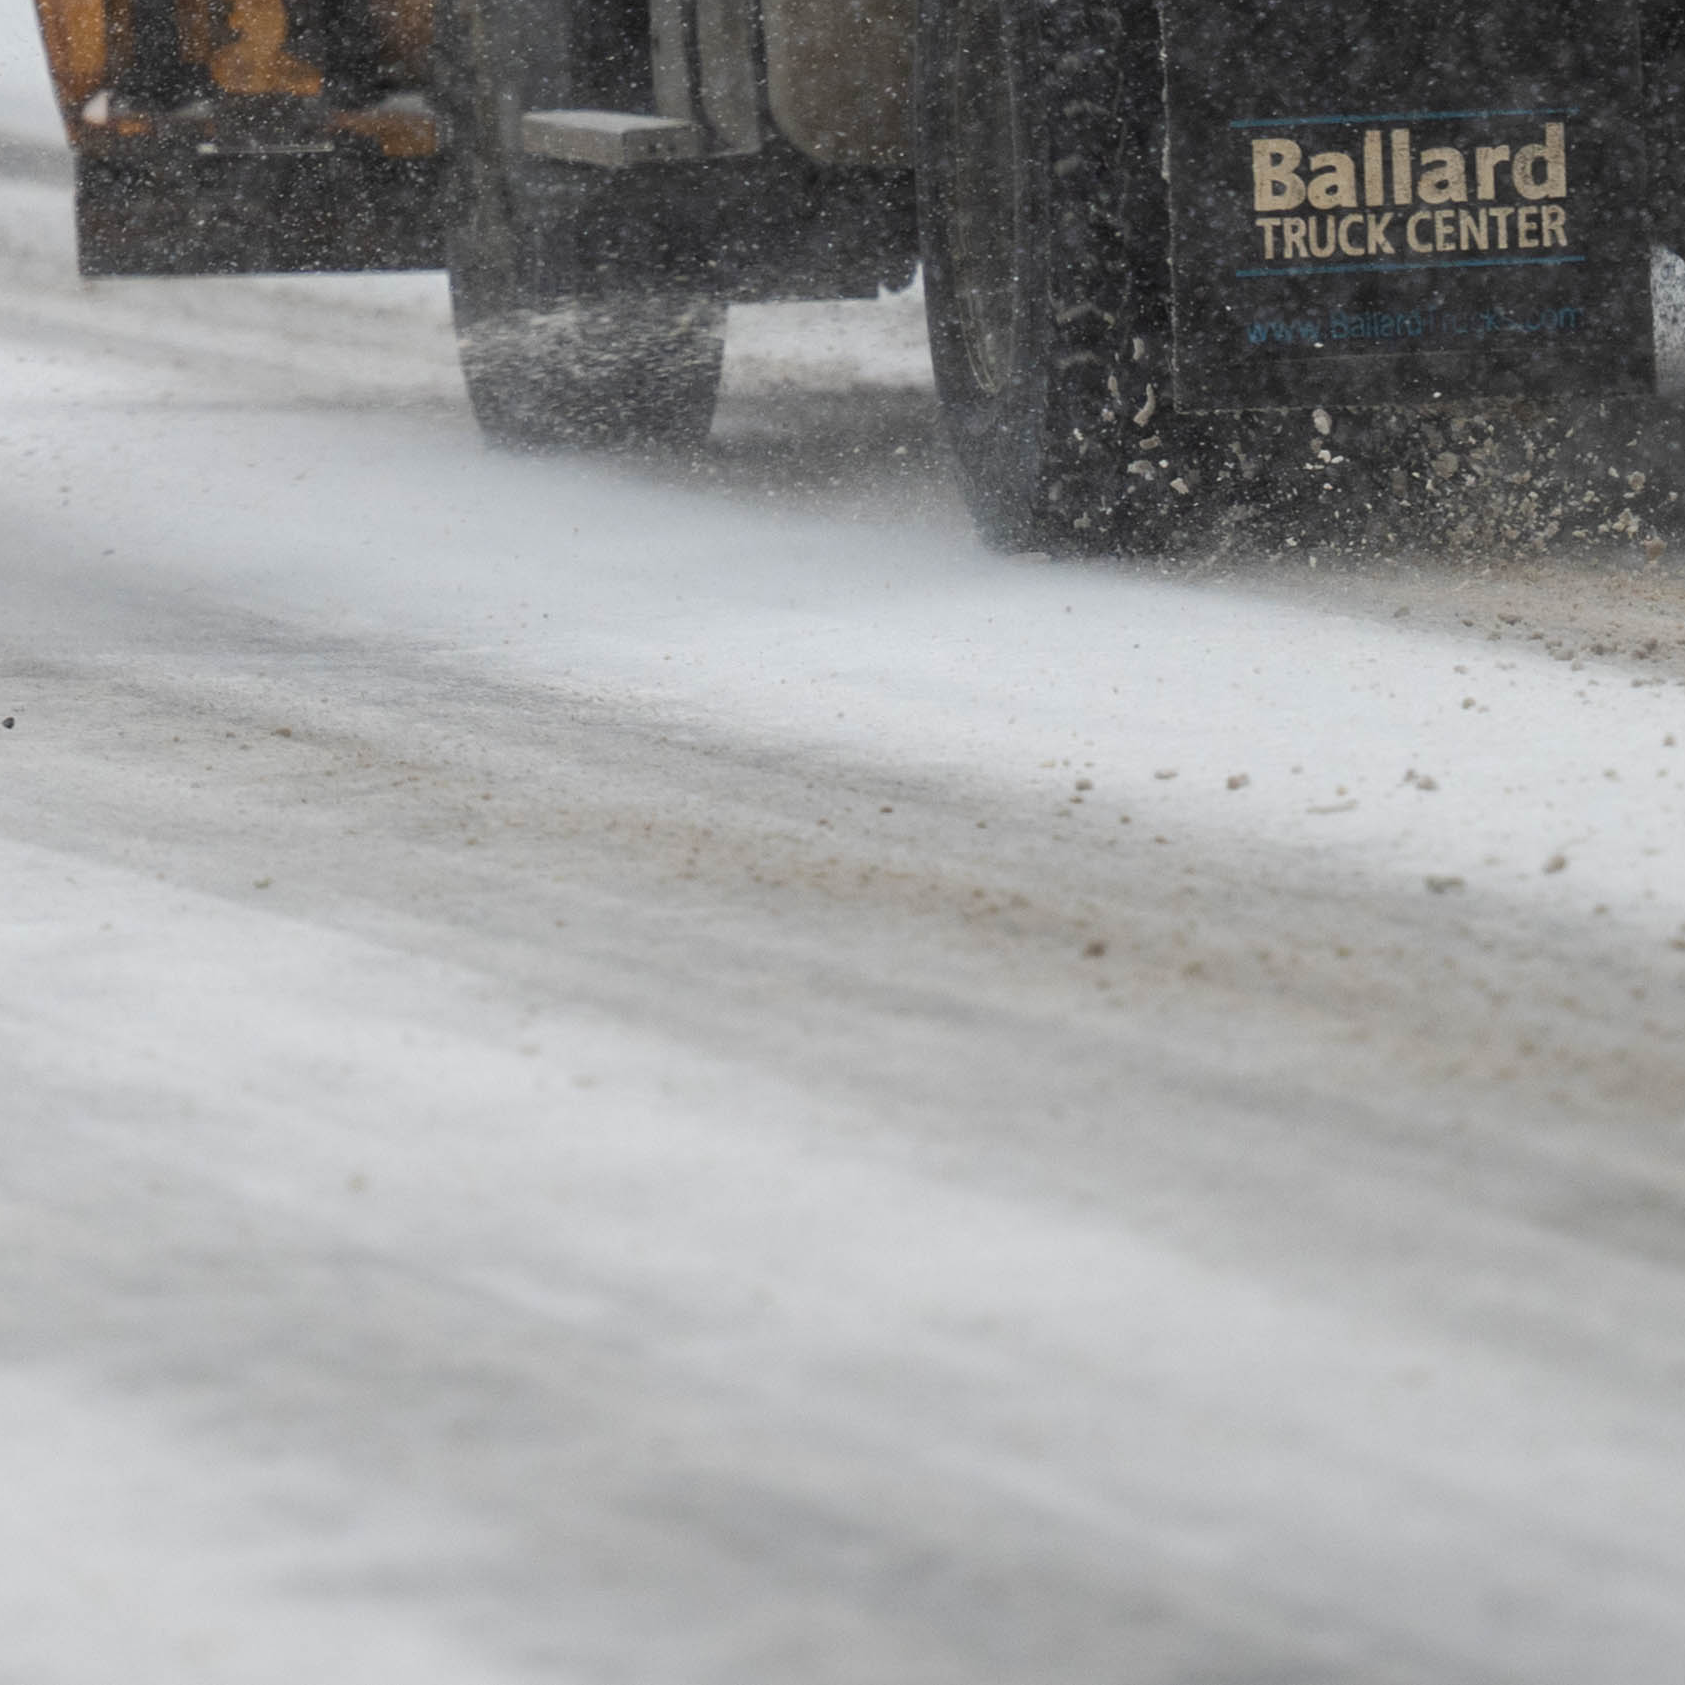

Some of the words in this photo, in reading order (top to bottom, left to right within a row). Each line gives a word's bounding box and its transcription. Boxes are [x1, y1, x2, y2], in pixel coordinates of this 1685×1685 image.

[1252, 122, 1567, 212] Ballard
[1256, 213, 1396, 260] TRUCK
[1406, 204, 1568, 254] CENTER
[1246, 305, 1584, 343] www.BallardTruks.com
